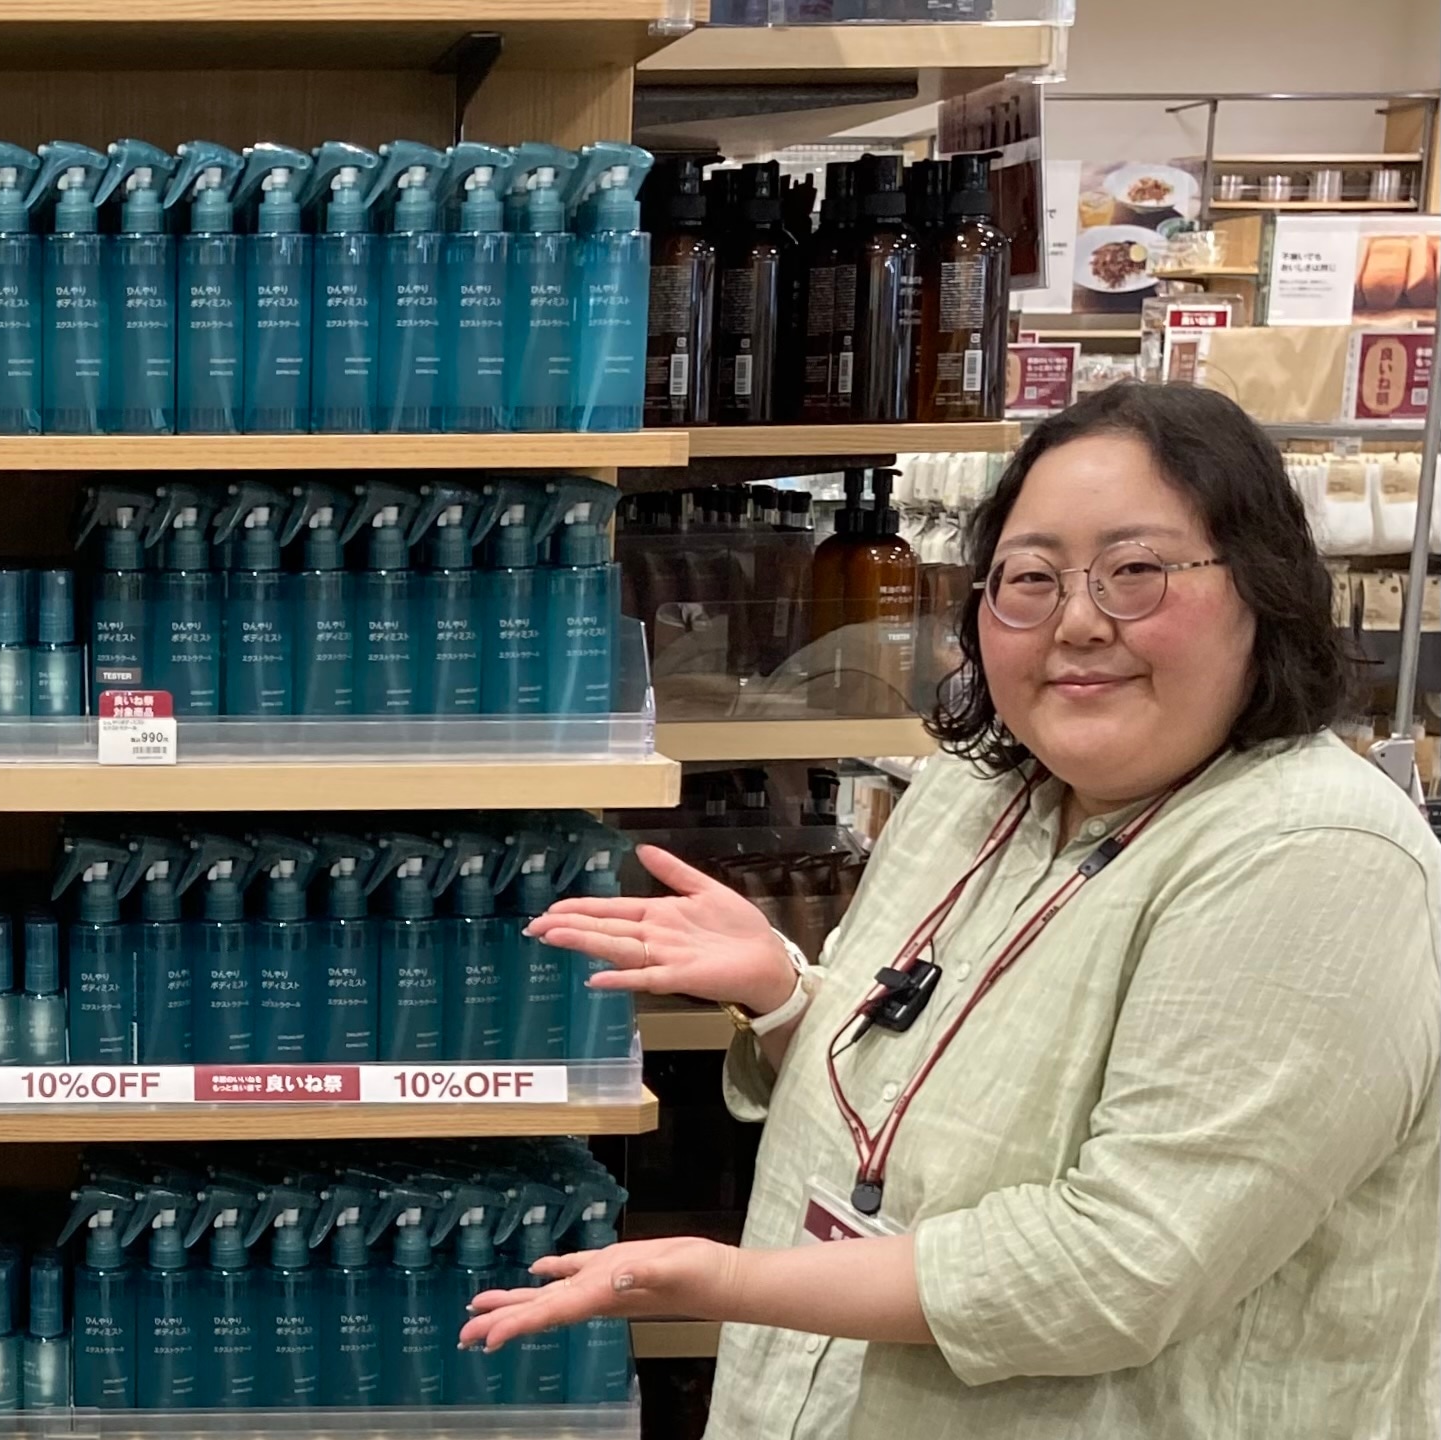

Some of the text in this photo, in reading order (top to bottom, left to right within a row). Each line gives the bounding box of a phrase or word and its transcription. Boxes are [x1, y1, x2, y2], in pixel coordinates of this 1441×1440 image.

[103, 672, 132, 680] TESTER
[21, 1072, 160, 1098] 10%OFF
[266, 1074, 343, 1094] 良いね祭
[394, 1072, 534, 1098] 10%OFF
